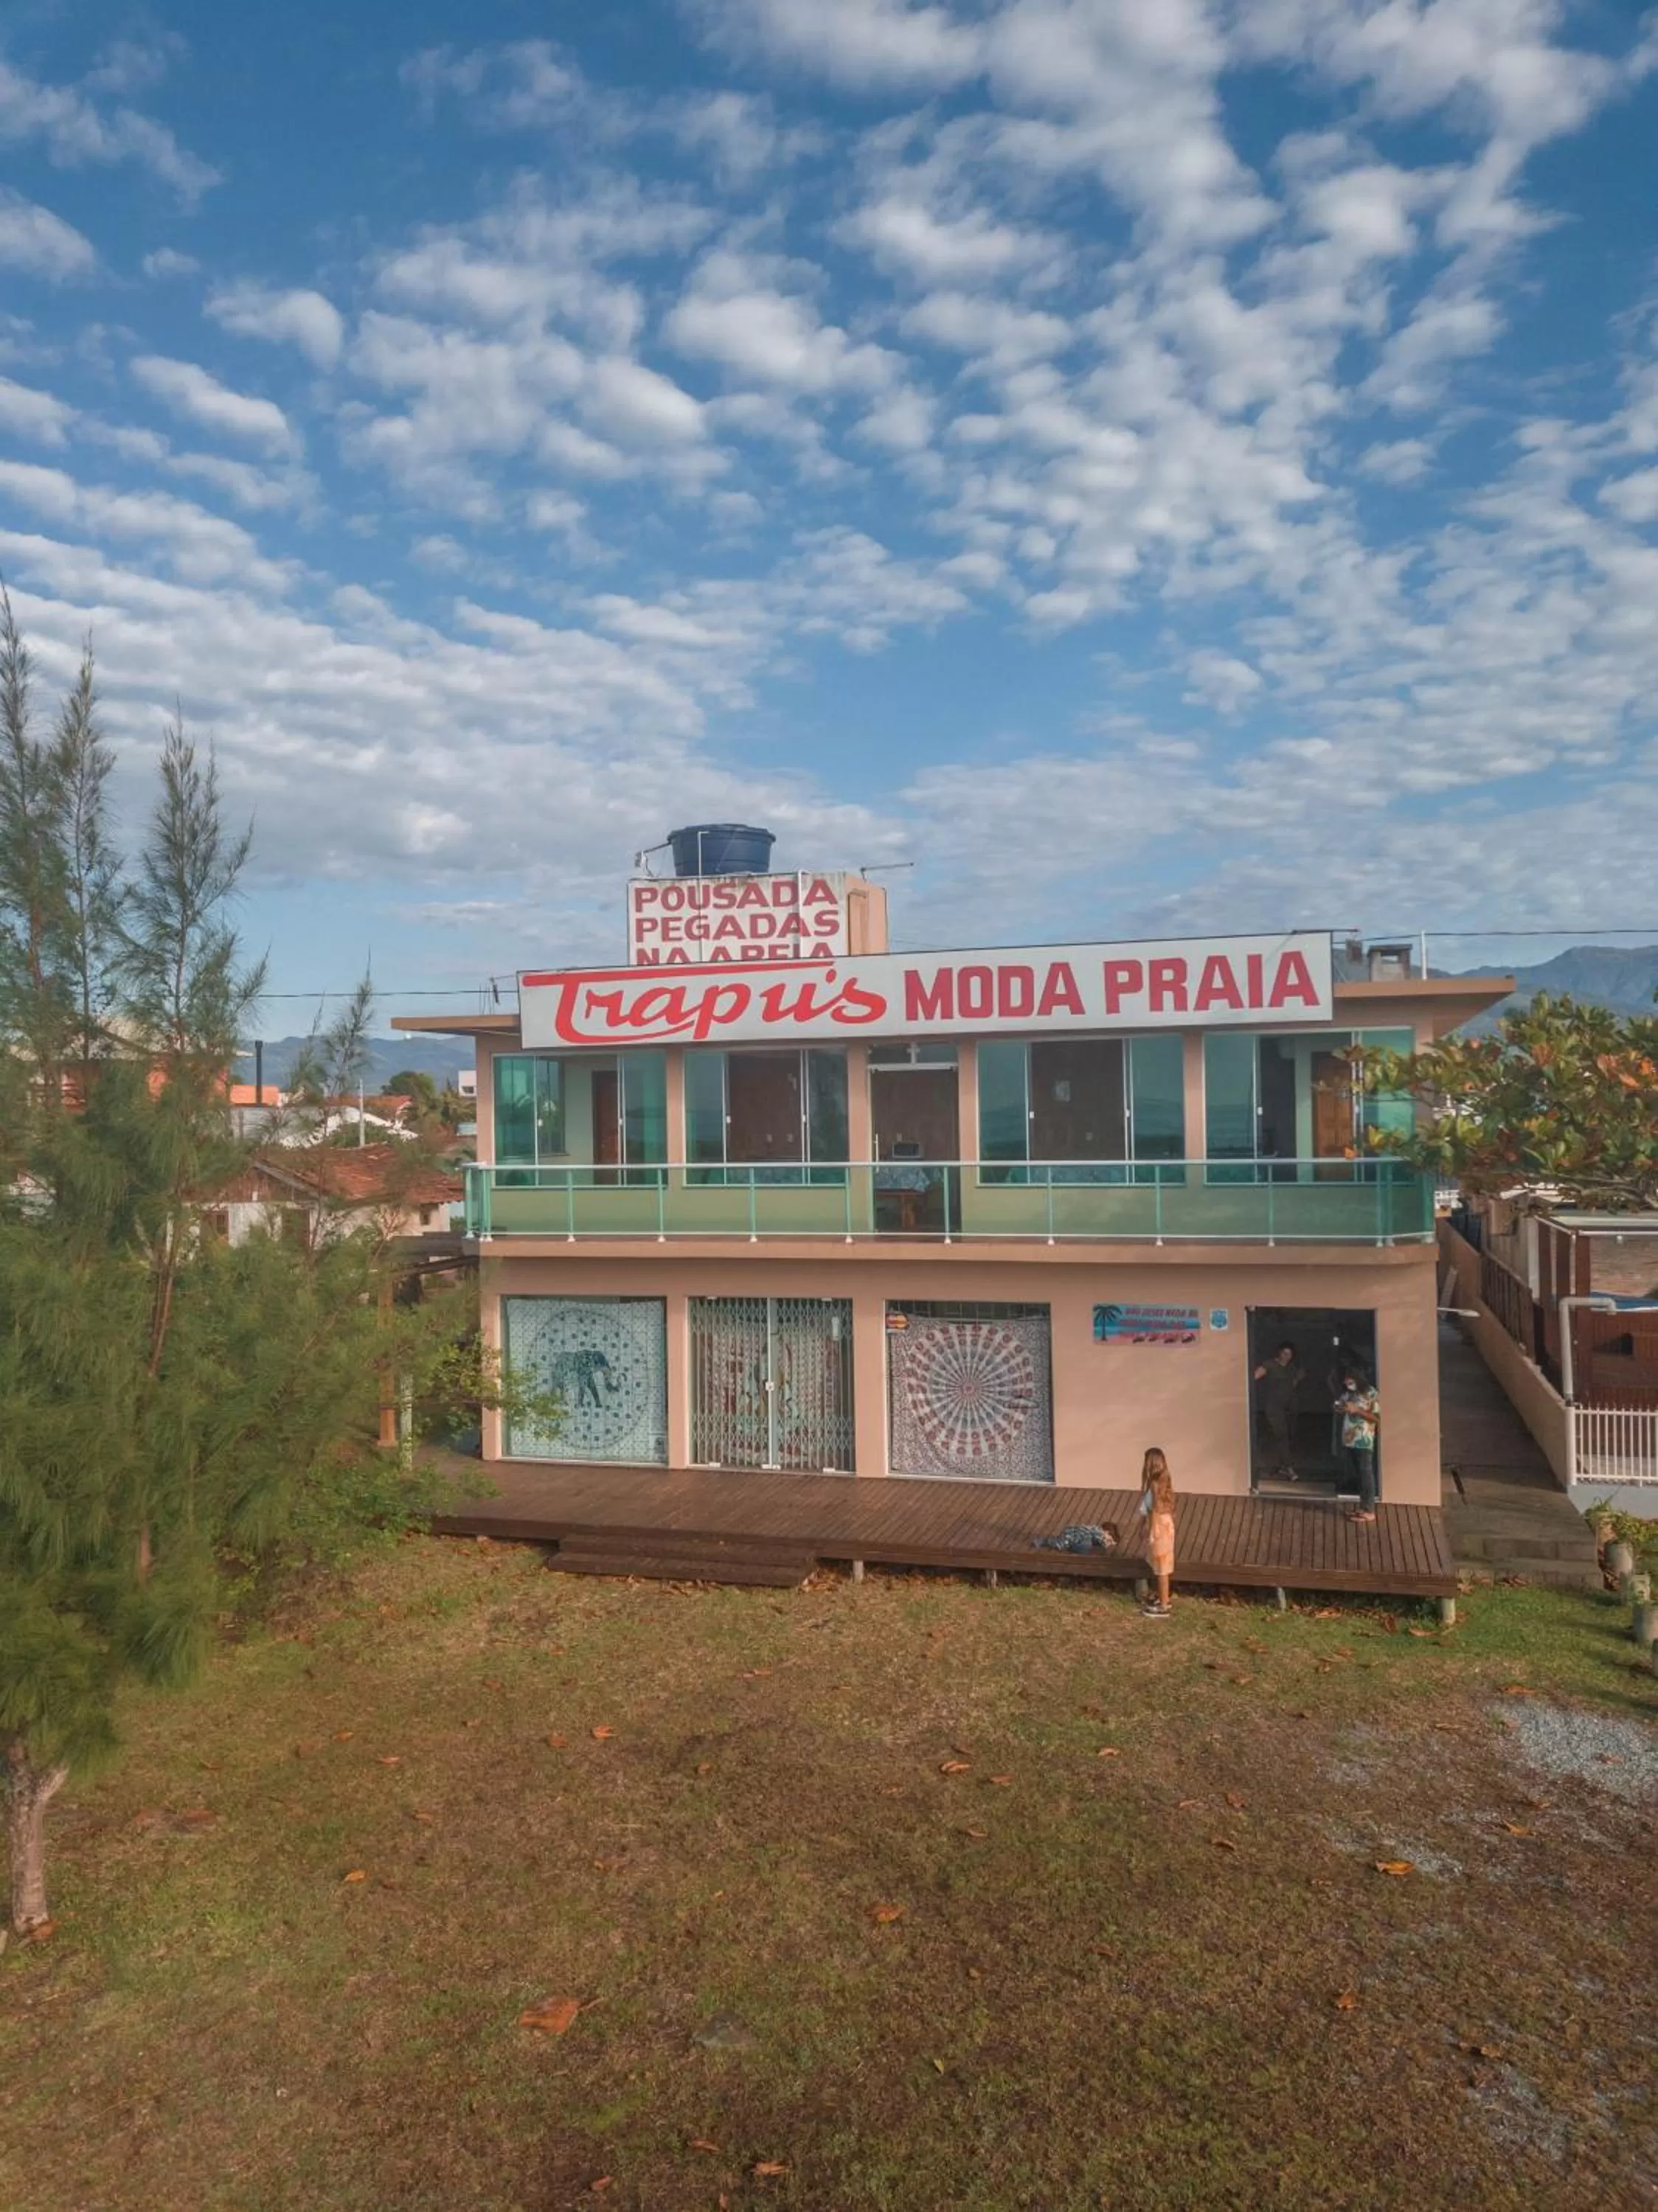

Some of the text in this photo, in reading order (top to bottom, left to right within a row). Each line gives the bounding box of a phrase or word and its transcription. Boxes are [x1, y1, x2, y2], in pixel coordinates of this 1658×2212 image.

[634, 878, 839, 913] POUSADA
[634, 909, 840, 943] PEGADAS
[636, 947, 690, 966] NA
[903, 961, 1086, 1022] MODA
[1103, 950, 1320, 1015] PRAIA
